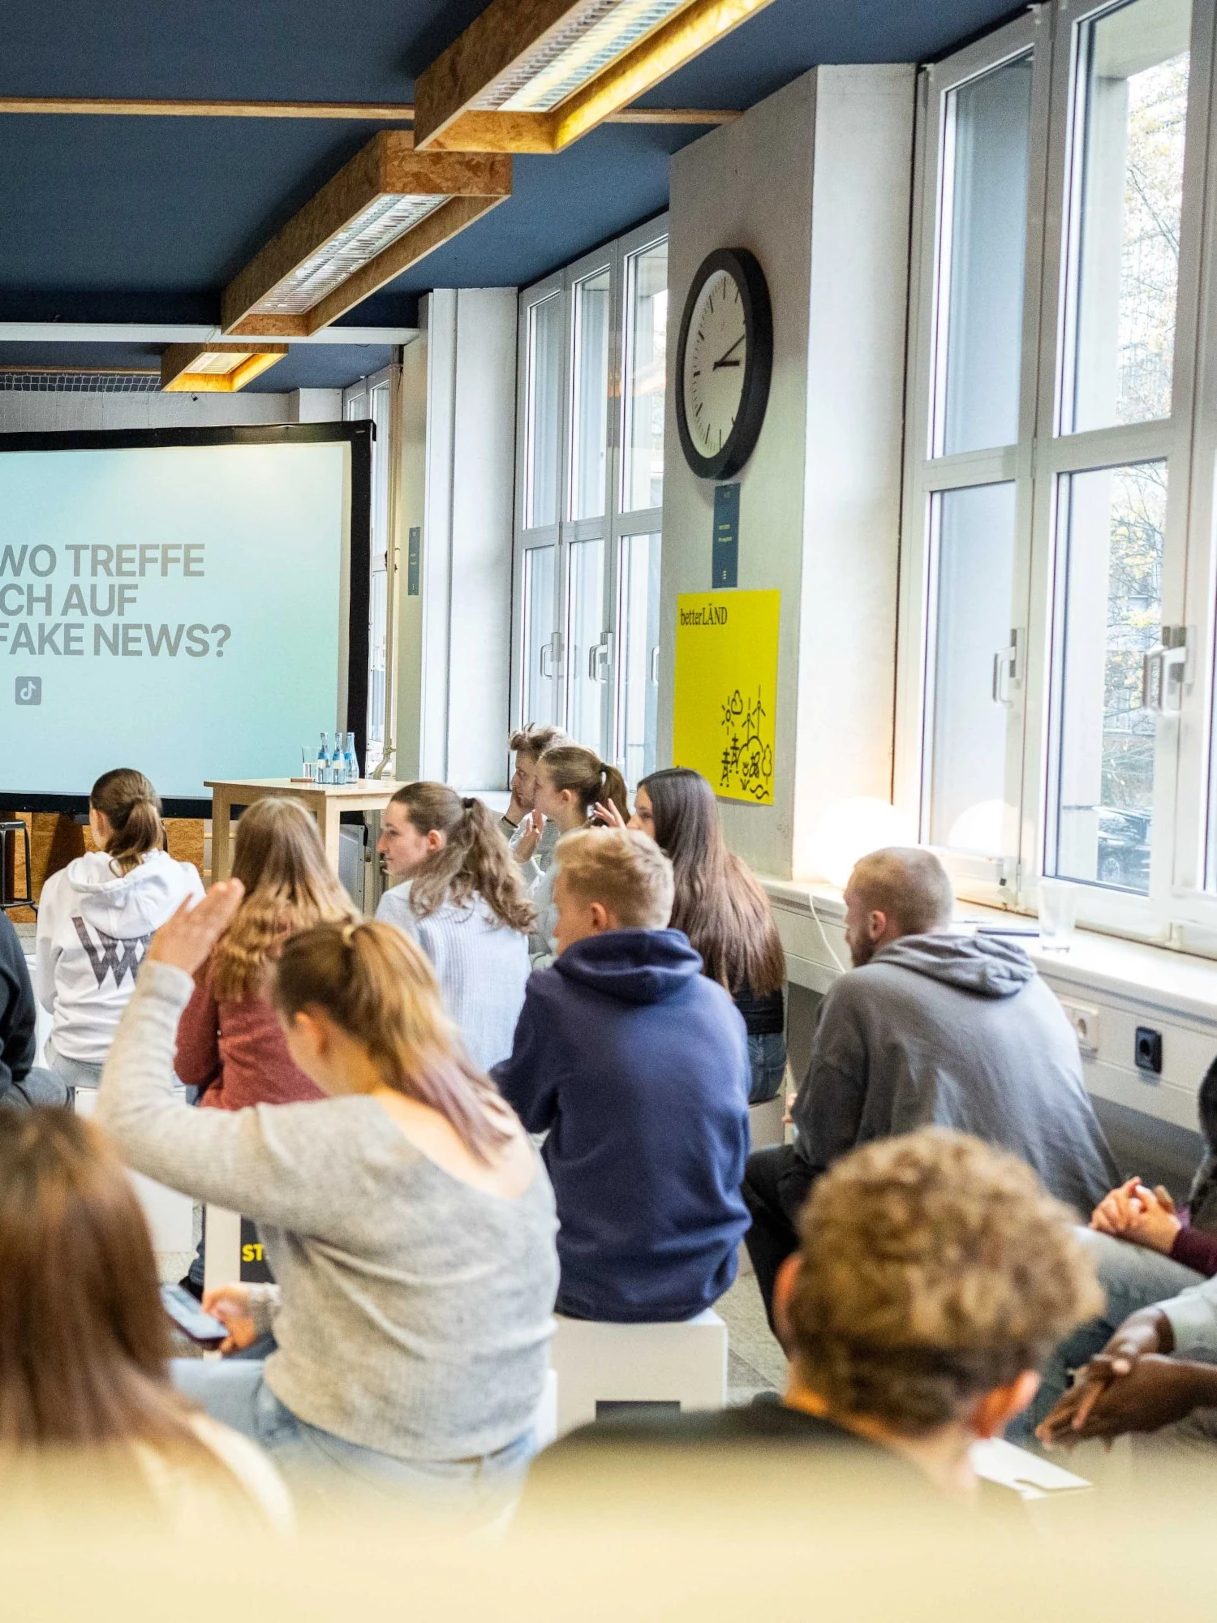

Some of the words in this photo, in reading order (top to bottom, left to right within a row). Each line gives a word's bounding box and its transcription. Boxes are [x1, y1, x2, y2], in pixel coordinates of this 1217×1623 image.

[65, 544, 205, 577] TREFFE
[60, 583, 139, 617] AUF
[93, 623, 231, 658] NEWS?
[242, 1243, 264, 1262] ST
